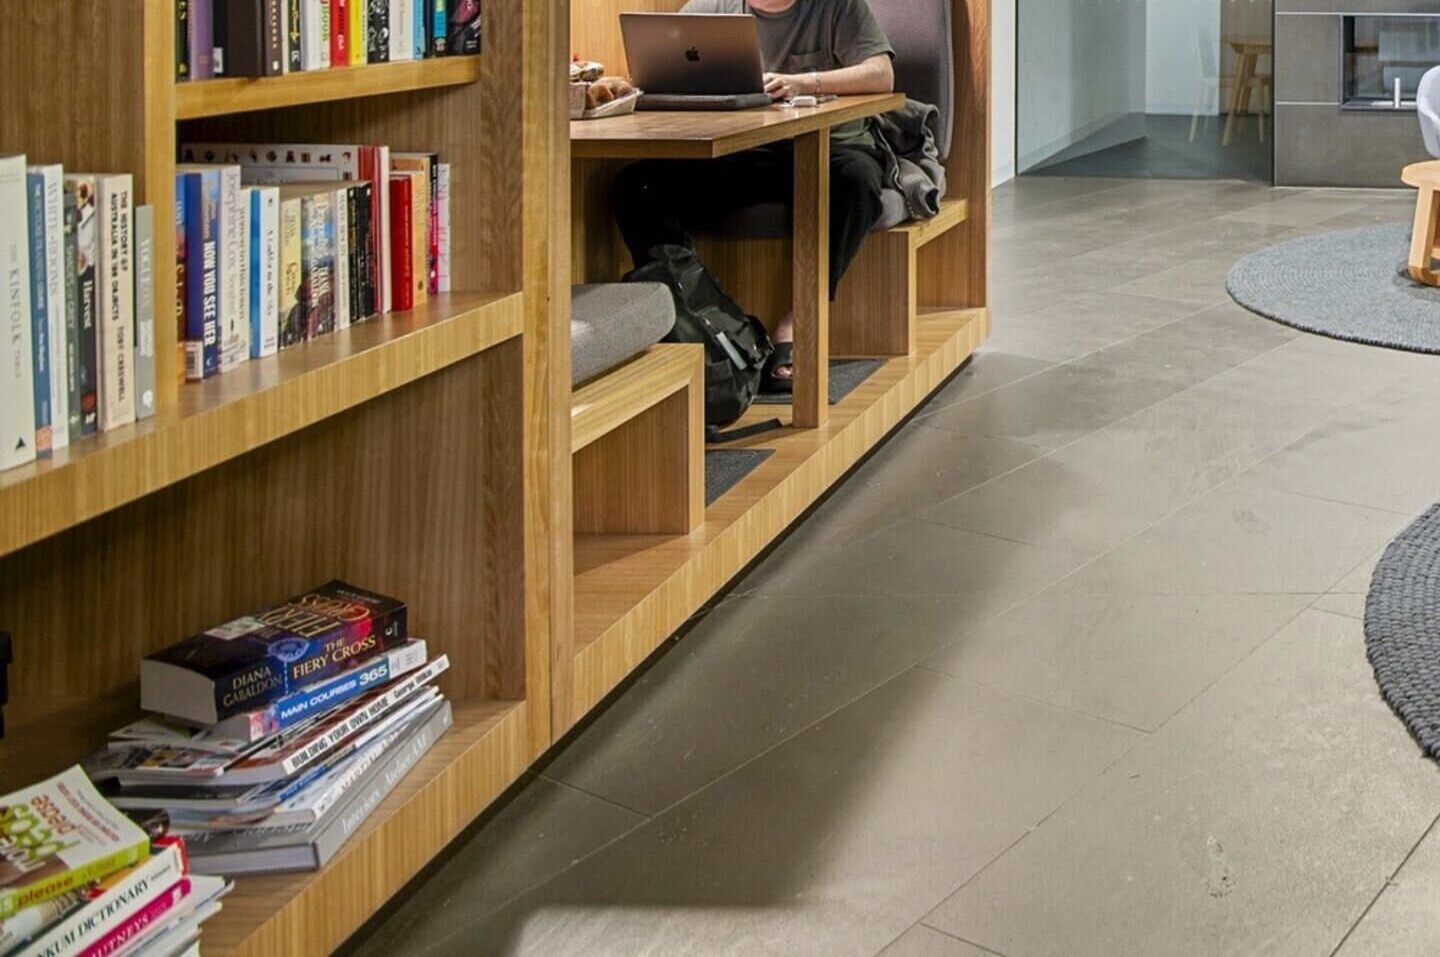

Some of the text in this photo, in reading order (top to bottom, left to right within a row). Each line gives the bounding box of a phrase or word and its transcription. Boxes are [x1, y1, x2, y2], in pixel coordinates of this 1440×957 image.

[120, 191, 128, 209] THE
[224, 173, 240, 239] Josephine
[66, 245, 74, 286] SHADES
[111, 248, 118, 259] IN
[203, 241, 216, 269] NOW
[228, 241, 239, 269] Cox
[203, 269, 216, 292] YOU
[9, 269, 22, 345] KINFOLK
[67, 301, 75, 329] GREY
[82, 280, 93, 330] Harvest
[203, 295, 216, 320] SEE
[117, 325, 125, 349] TOBY
[203, 322, 216, 346] HER
[292, 634, 377, 680] FIERY CROSS
[324, 636, 345, 653] THE
[222, 674, 283, 709] GABALDON
[232, 665, 272, 690] DIANA
[280, 664, 388, 720] MAIN COURSES 365
[291, 737, 329, 769] BUILDING
[329, 725, 349, 744] YOUR
[350, 712, 368, 729] OWN
[369, 697, 390, 717] HOME
[341, 791, 380, 834] Interiors
[18, 876, 74, 909] please
[77, 876, 149, 938] DICTIONARY
